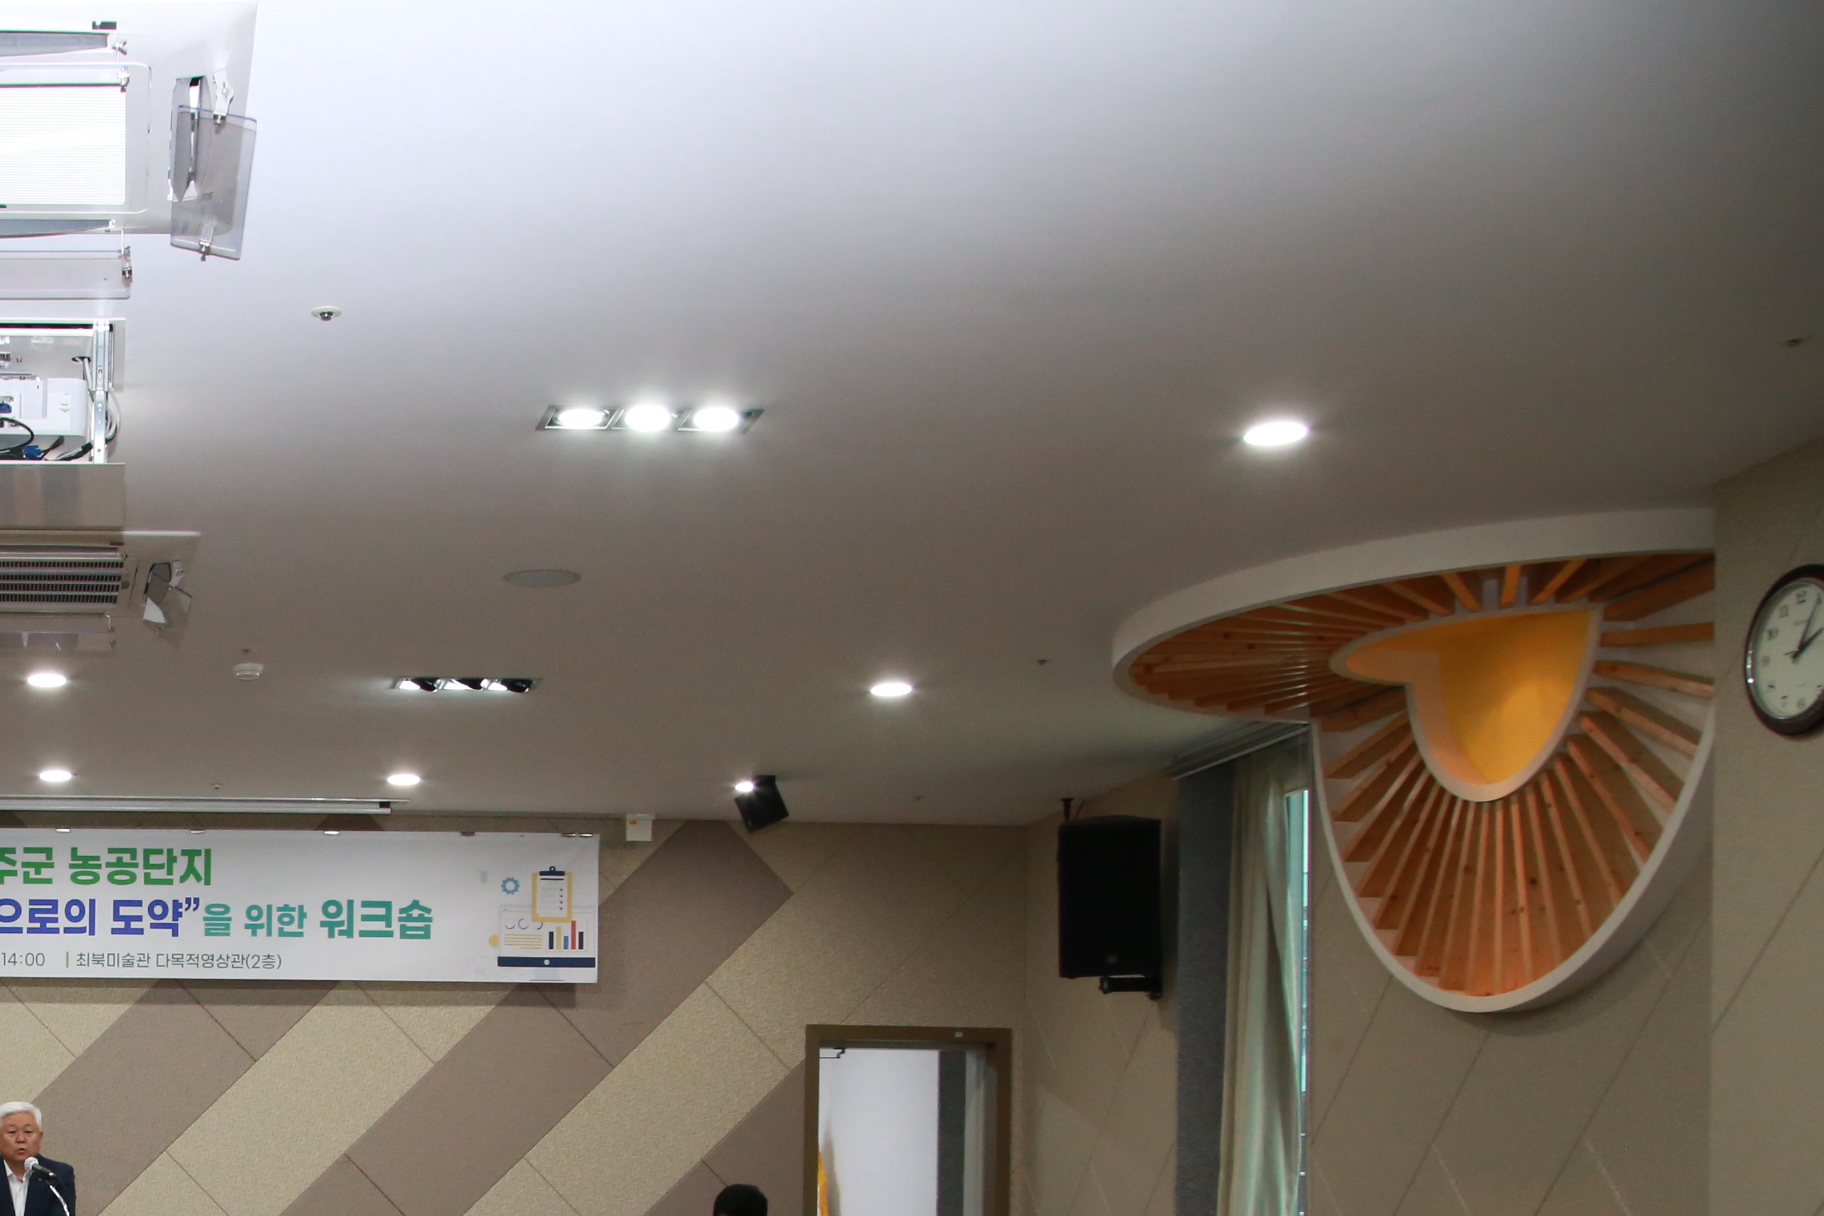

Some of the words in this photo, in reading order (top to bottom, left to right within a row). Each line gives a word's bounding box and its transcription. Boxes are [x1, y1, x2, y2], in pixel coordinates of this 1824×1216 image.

[68, 846, 212, 886] 농공단지
[243, 903, 308, 938] 위한
[319, 899, 434, 940] 워크숍
[0, 951, 46, 968] 14:00
[76, 951, 152, 968] 최북미술관
[155, 952, 283, 970] 다목적영상관(2층)
